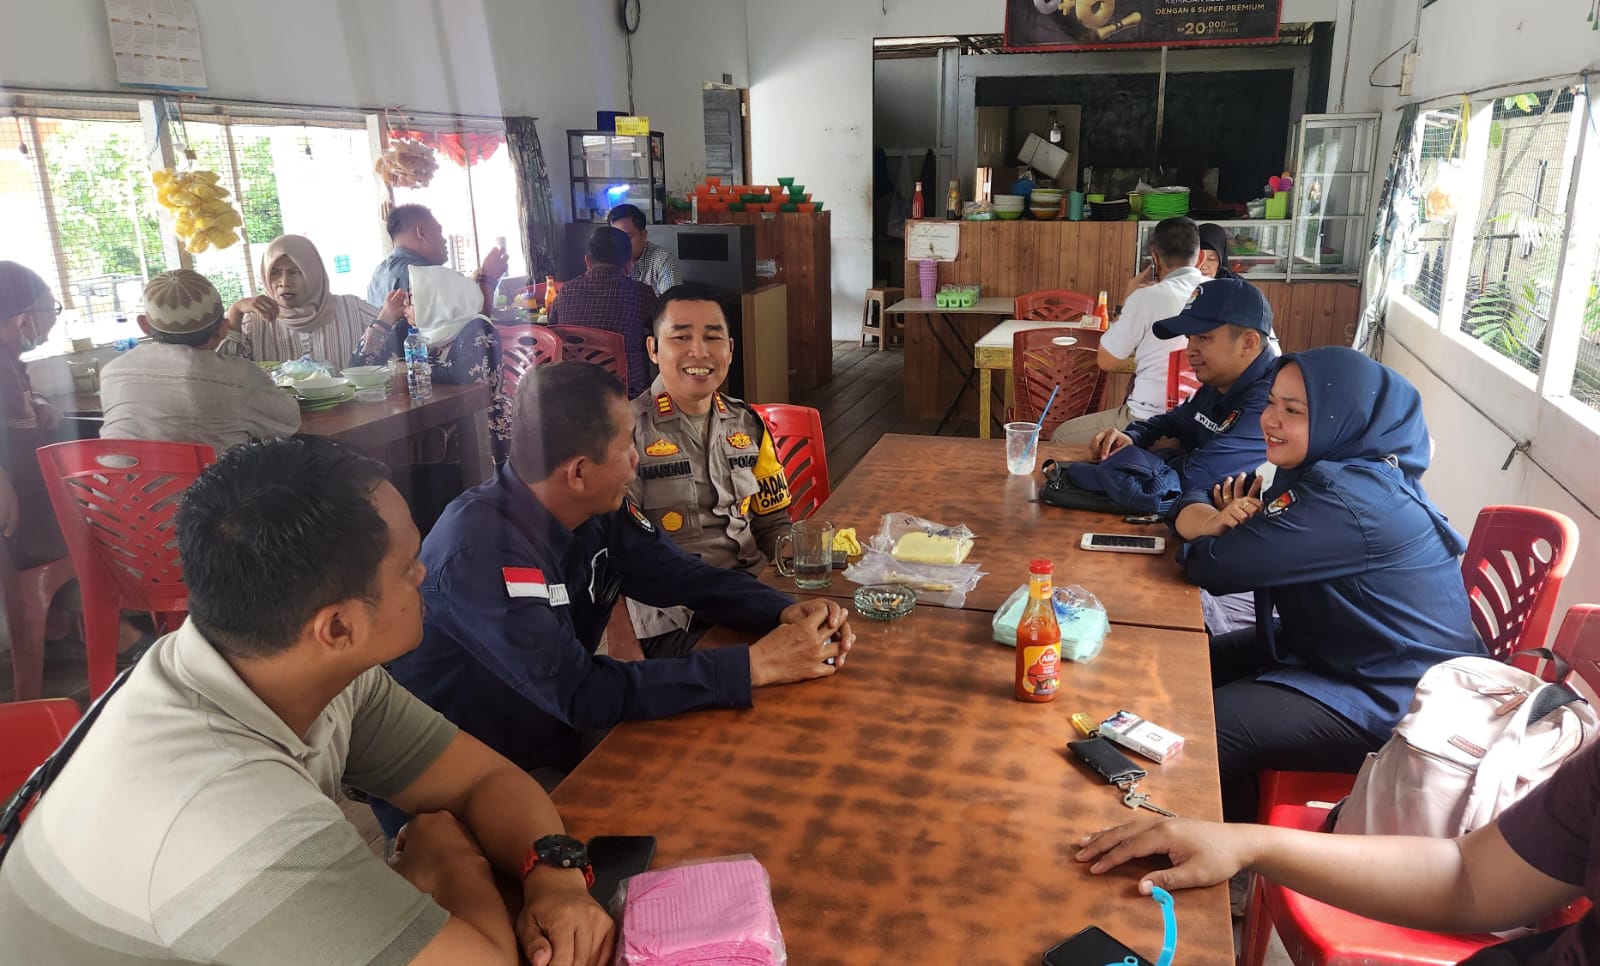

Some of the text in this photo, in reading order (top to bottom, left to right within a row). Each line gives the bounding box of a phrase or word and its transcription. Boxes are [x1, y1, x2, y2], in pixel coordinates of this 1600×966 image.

[1155, 7, 1189, 15] DENGAN
[1197, 5, 1224, 13] SUPER
[1226, 3, 1265, 12] PREMIUM
[761, 492, 785, 508] OMP
